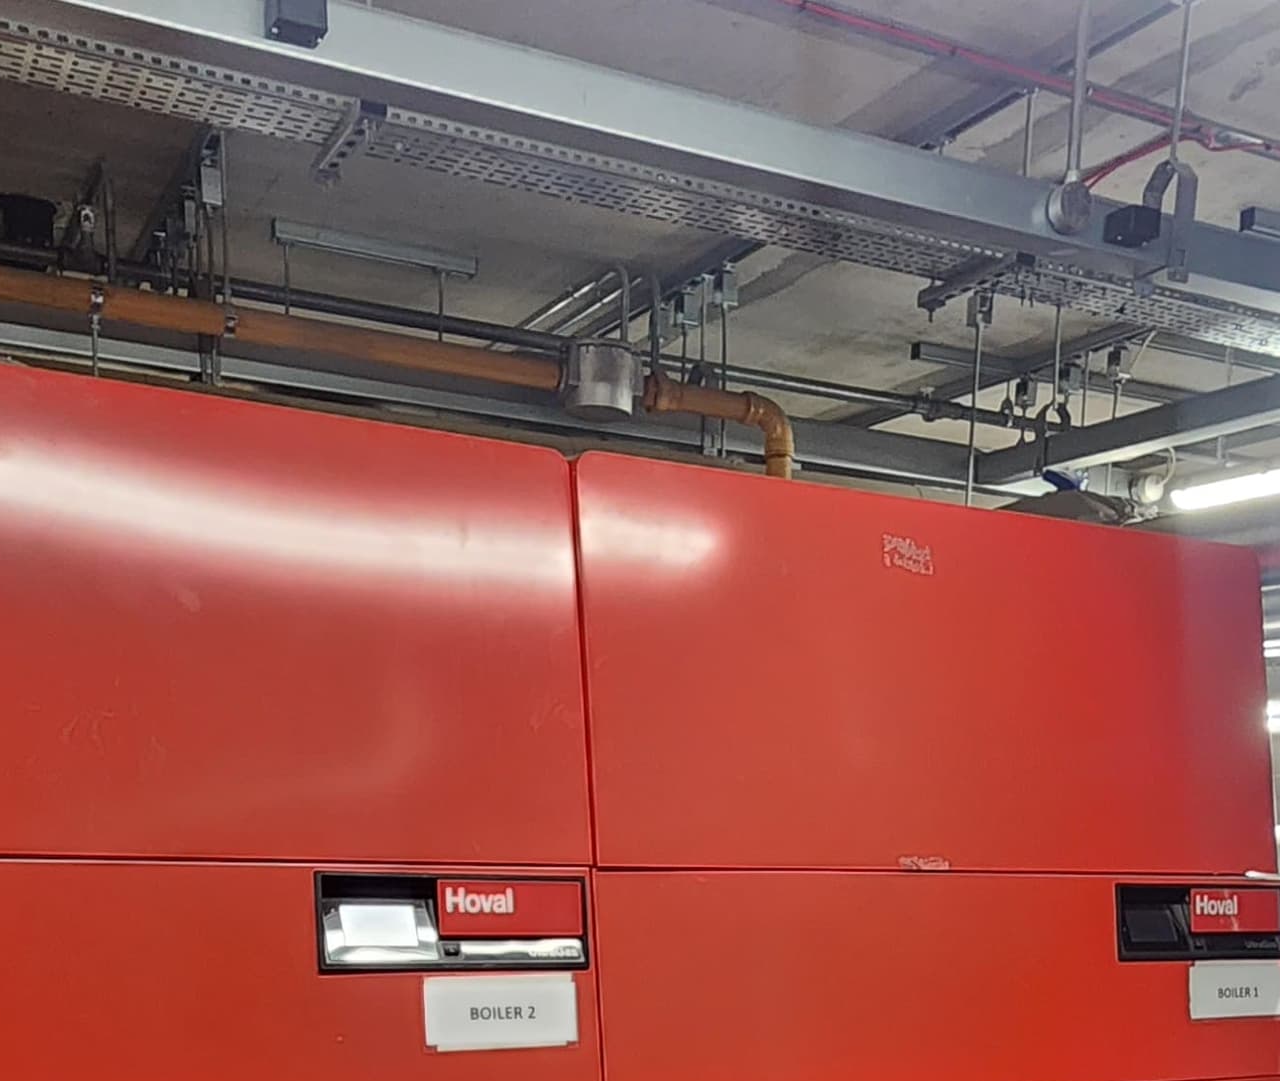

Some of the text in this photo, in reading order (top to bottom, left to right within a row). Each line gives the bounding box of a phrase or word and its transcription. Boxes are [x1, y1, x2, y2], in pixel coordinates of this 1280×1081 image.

[445, 886, 514, 914] Hoval
[1195, 894, 1238, 915] Hoval
[1217, 986, 1259, 999] BOILER 1
[469, 1005, 536, 1021] BOILER 2
